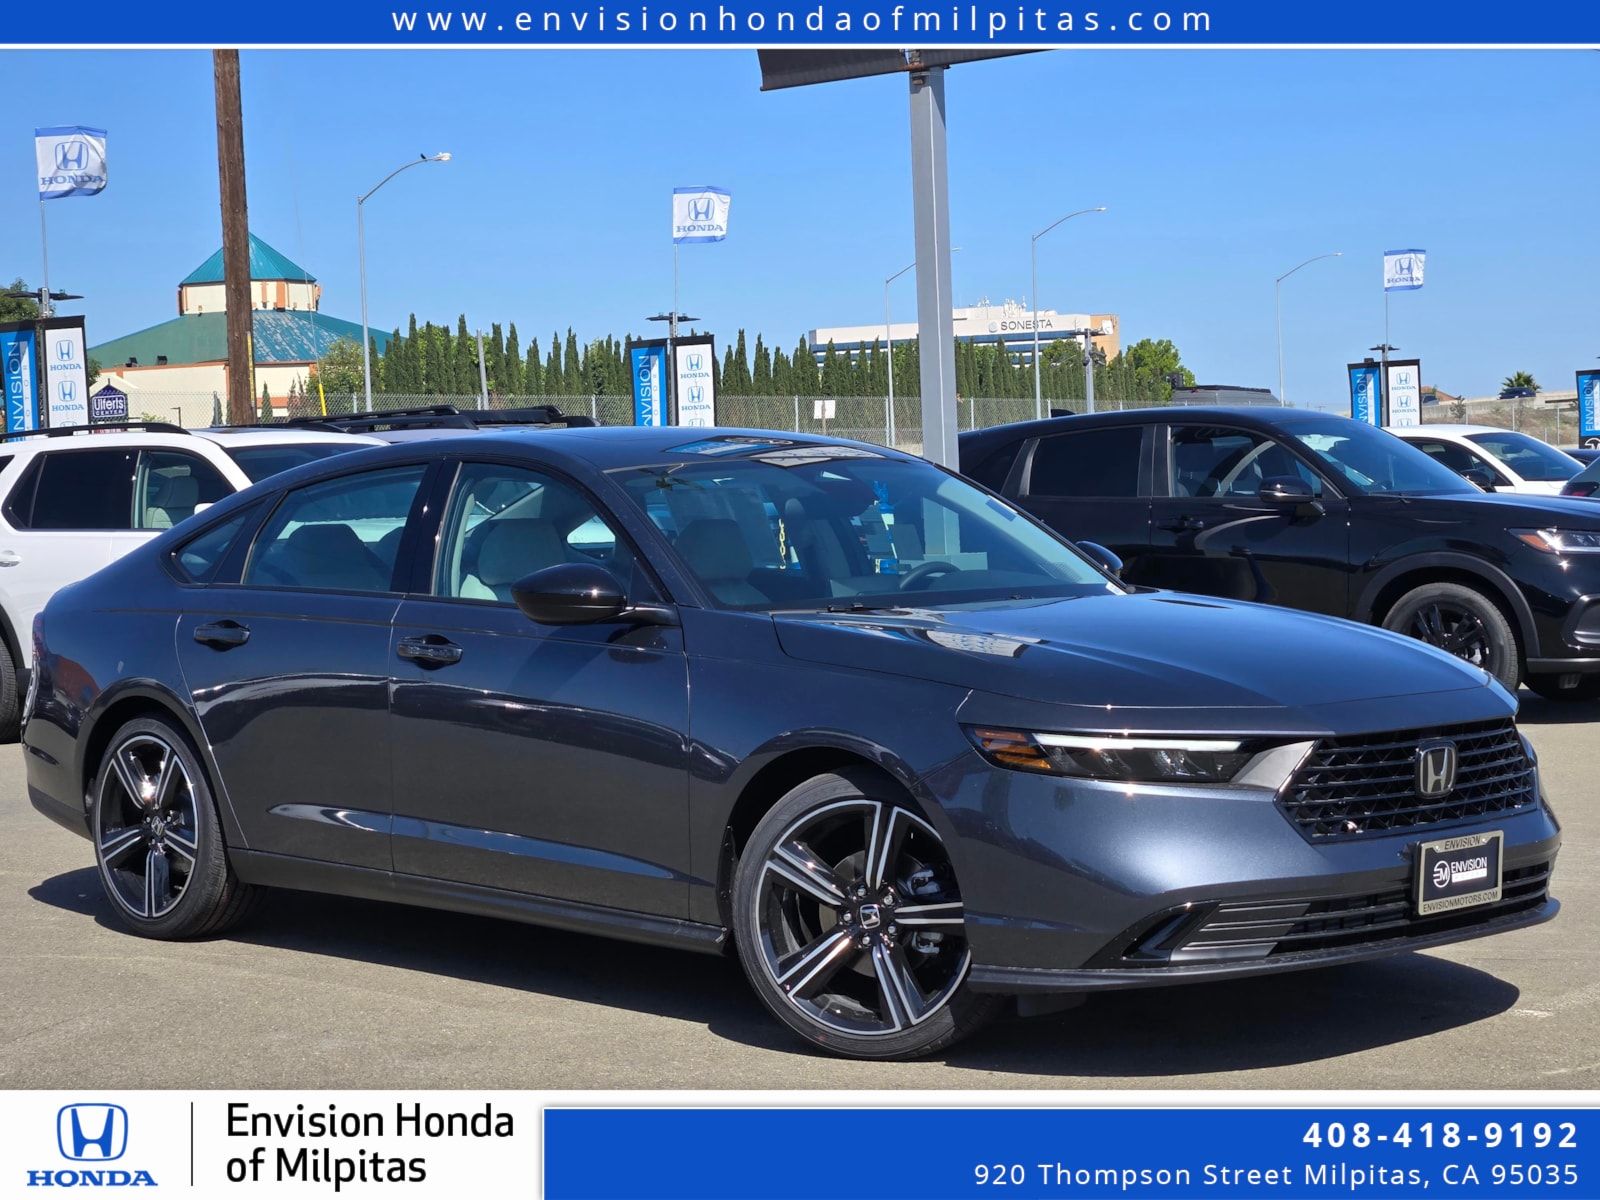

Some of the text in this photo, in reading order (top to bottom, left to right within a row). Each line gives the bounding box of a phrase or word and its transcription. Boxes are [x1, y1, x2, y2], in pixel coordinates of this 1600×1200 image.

[40, 175, 104, 186] HONDA
[676, 224, 724, 233] HONDA
[1001, 319, 1052, 331] SONESTA
[50, 363, 82, 371] HONDA
[7, 341, 25, 431] NVISION
[639, 355, 652, 427] NVISION
[94, 397, 124, 411] Ulferts
[1357, 373, 1368, 422] NVISION
[51, 403, 85, 412] HONDA
[1583, 378, 1594, 432] ENVISION
[1444, 836, 1481, 850] ENVISION
[1450, 856, 1488, 874] ENVISION
[1423, 890, 1498, 913] ENVISIONMOTORS.COM
